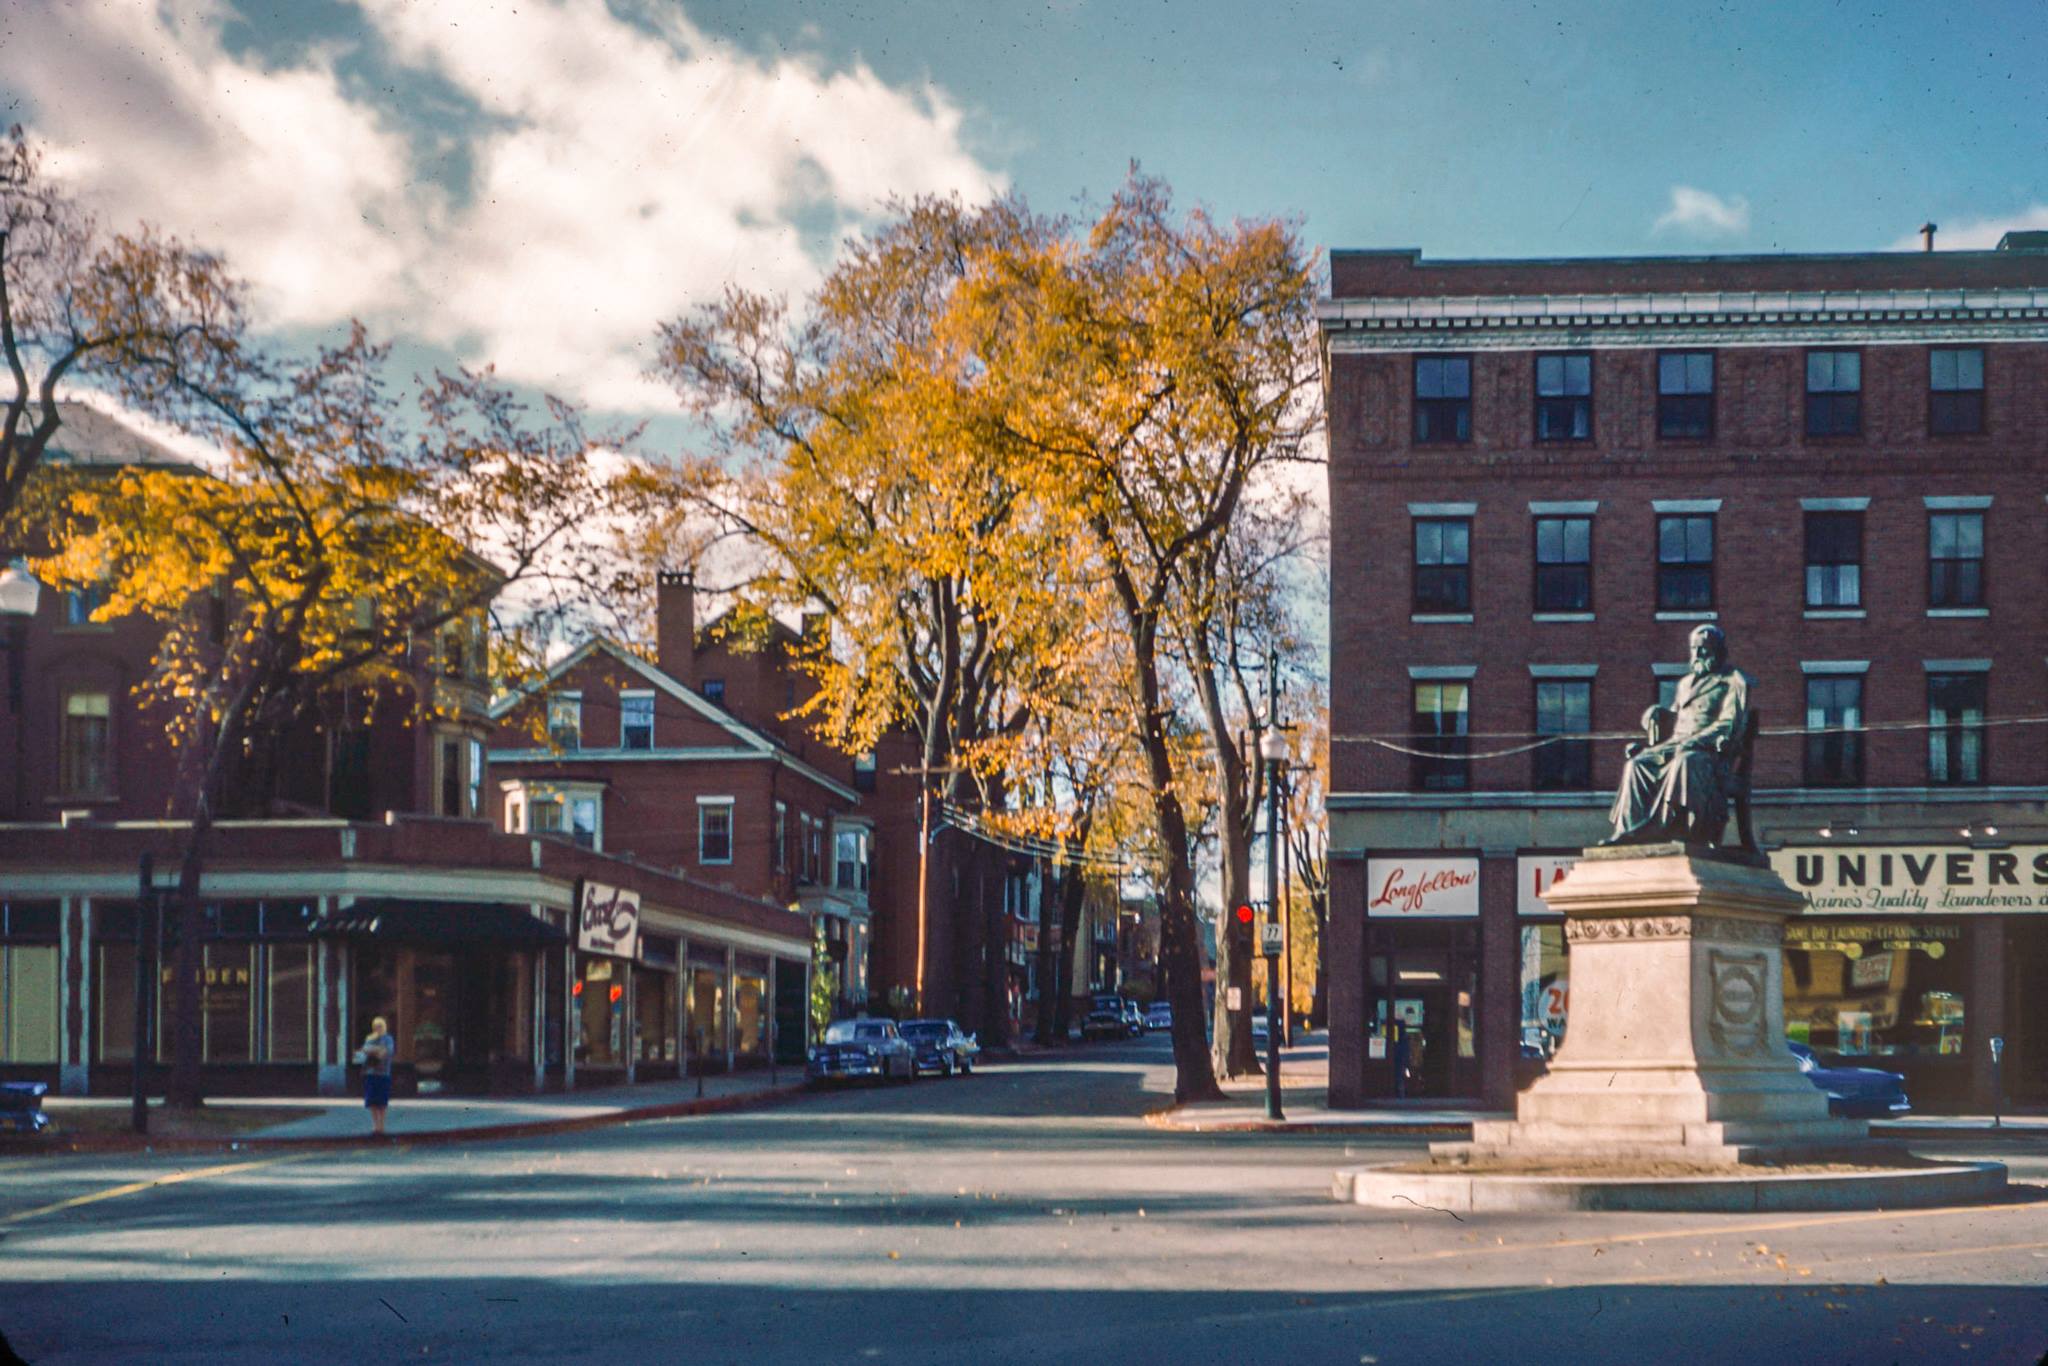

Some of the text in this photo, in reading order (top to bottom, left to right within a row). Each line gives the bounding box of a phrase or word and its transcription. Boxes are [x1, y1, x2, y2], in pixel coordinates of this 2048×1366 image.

[1370, 868, 1476, 912] Longfellow
[1866, 888, 1929, 911] Quality
[1936, 887, 2032, 910] Launderers
